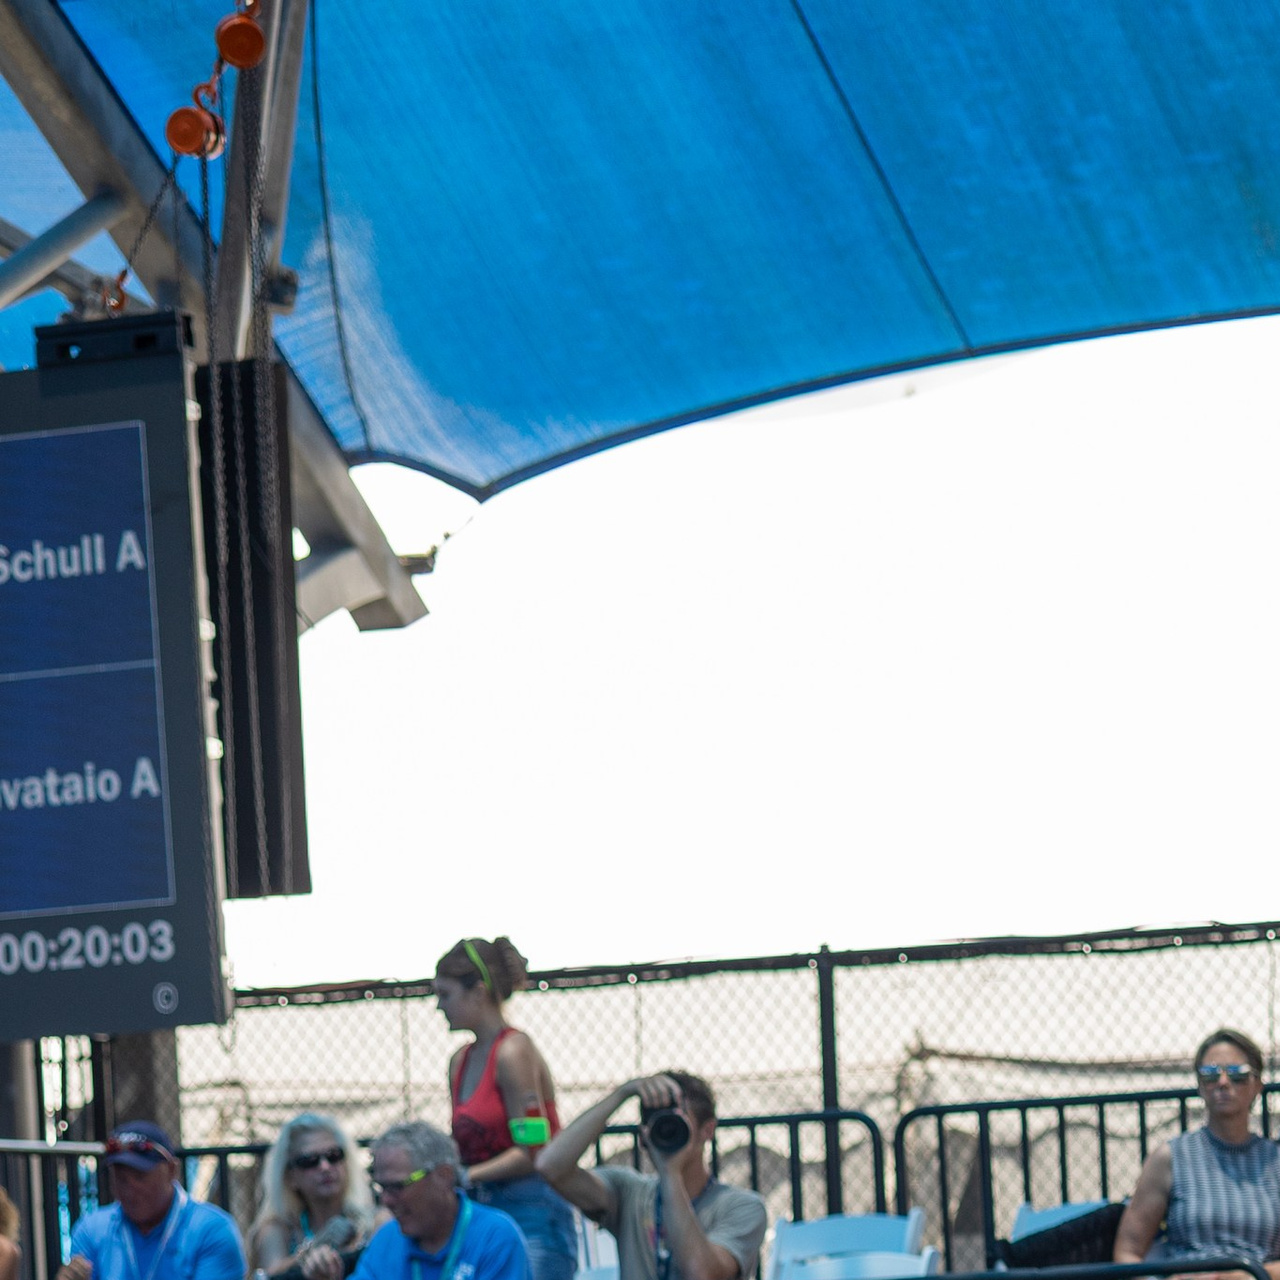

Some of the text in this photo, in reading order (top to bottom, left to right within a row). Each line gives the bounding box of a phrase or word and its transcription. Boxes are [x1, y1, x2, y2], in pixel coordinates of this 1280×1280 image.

[116, 529, 147, 573] A
[0, 756, 161, 810] vataio A
[0, 919, 176, 976] 00:20:03
